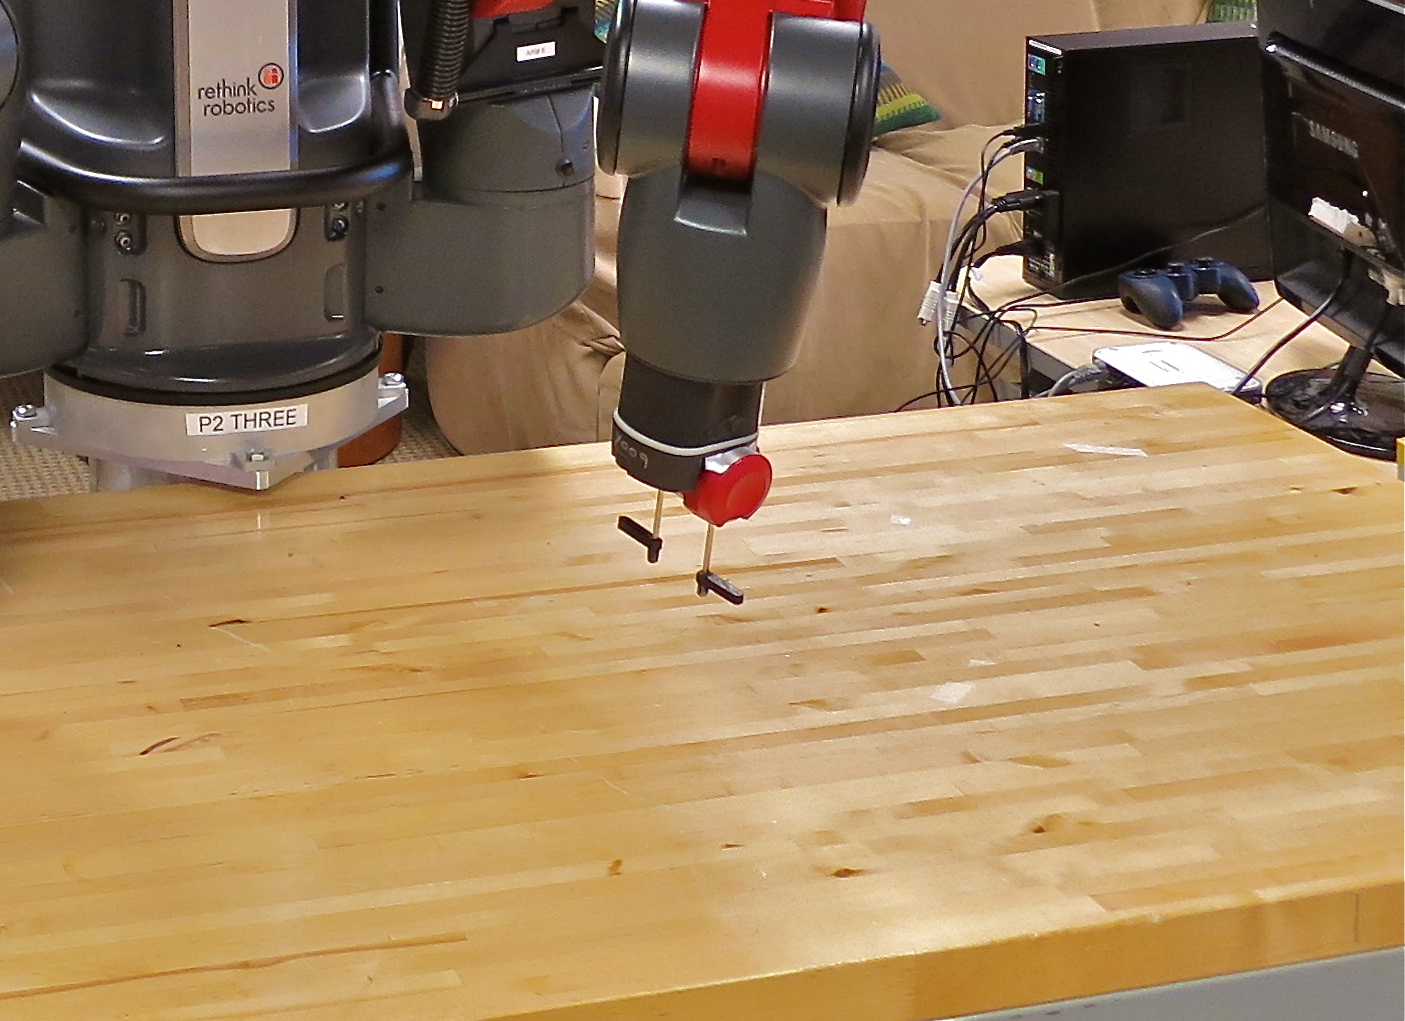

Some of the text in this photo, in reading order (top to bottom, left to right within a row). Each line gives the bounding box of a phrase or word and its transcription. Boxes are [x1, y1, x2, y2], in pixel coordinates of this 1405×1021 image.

[197, 76, 258, 101] rethink
[203, 97, 276, 117] robotics
[1308, 120, 1359, 159] SAMSUNG
[198, 408, 298, 433] P2 THREE
